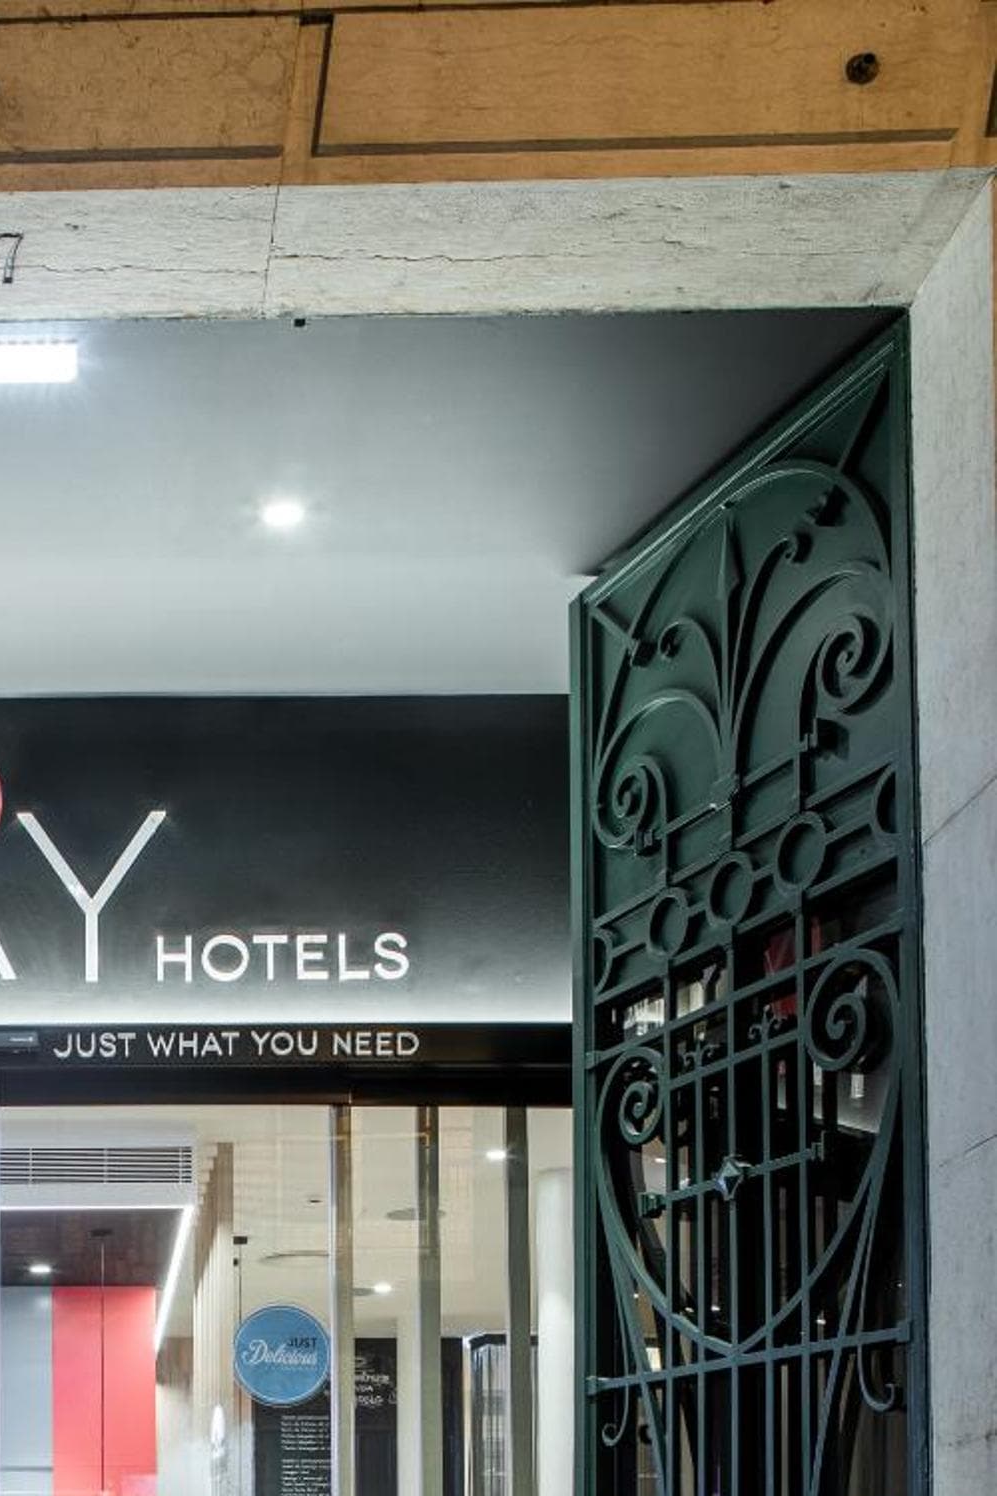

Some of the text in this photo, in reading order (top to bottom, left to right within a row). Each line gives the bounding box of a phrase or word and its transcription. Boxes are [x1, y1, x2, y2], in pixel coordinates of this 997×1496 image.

[156, 932, 410, 983] HOTELS
[53, 1030, 420, 1058] JUST WHAT YOU NEED
[287, 1337, 317, 1350] JUST
